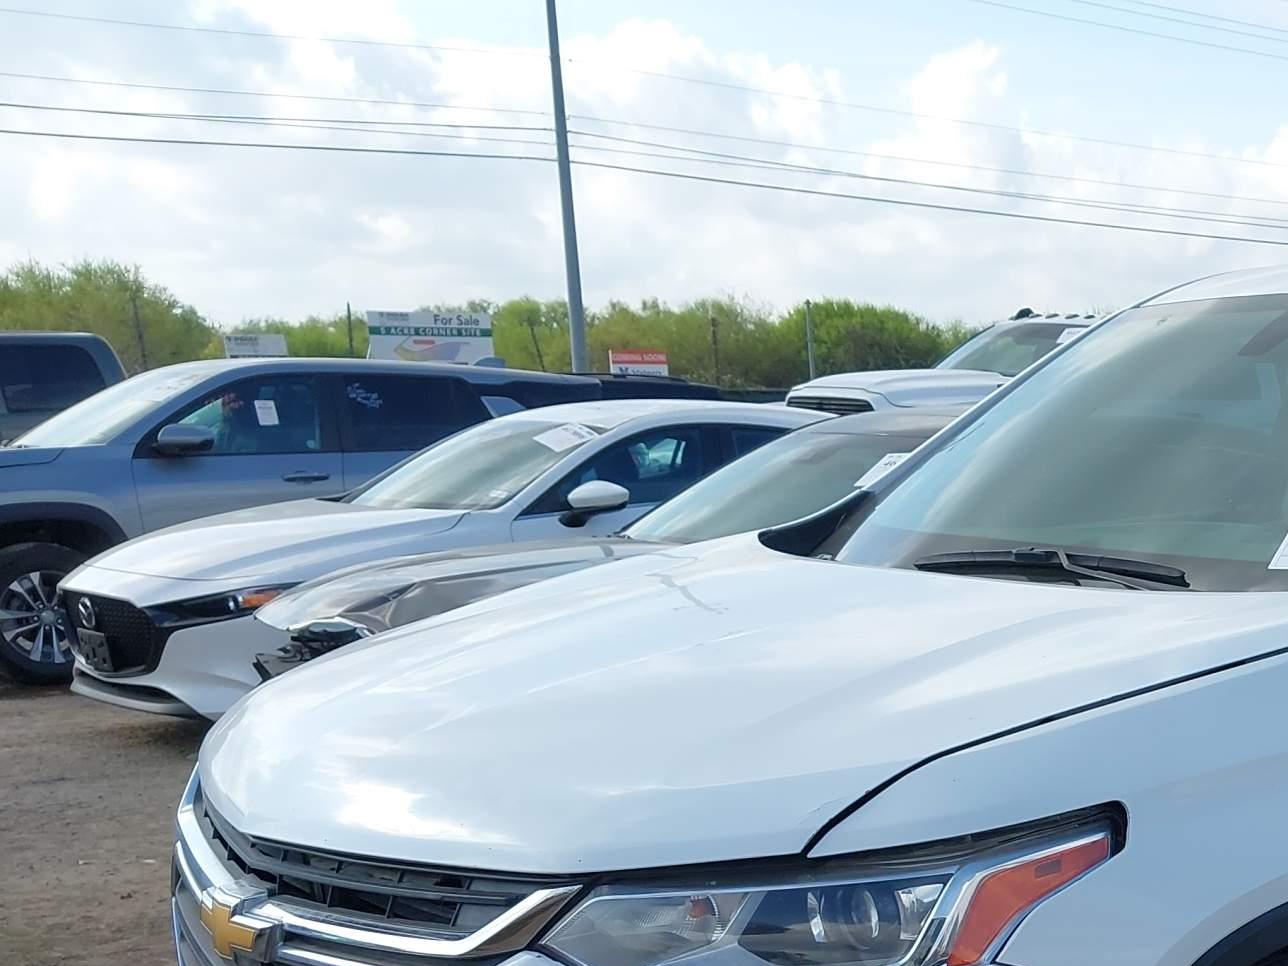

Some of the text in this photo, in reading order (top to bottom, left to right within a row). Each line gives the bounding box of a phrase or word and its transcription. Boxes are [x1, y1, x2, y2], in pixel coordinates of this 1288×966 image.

[433, 314, 480, 327] For Sale
[390, 328, 415, 336] ACRE
[419, 328, 458, 337] CORNER
[461, 328, 481, 337] SITE
